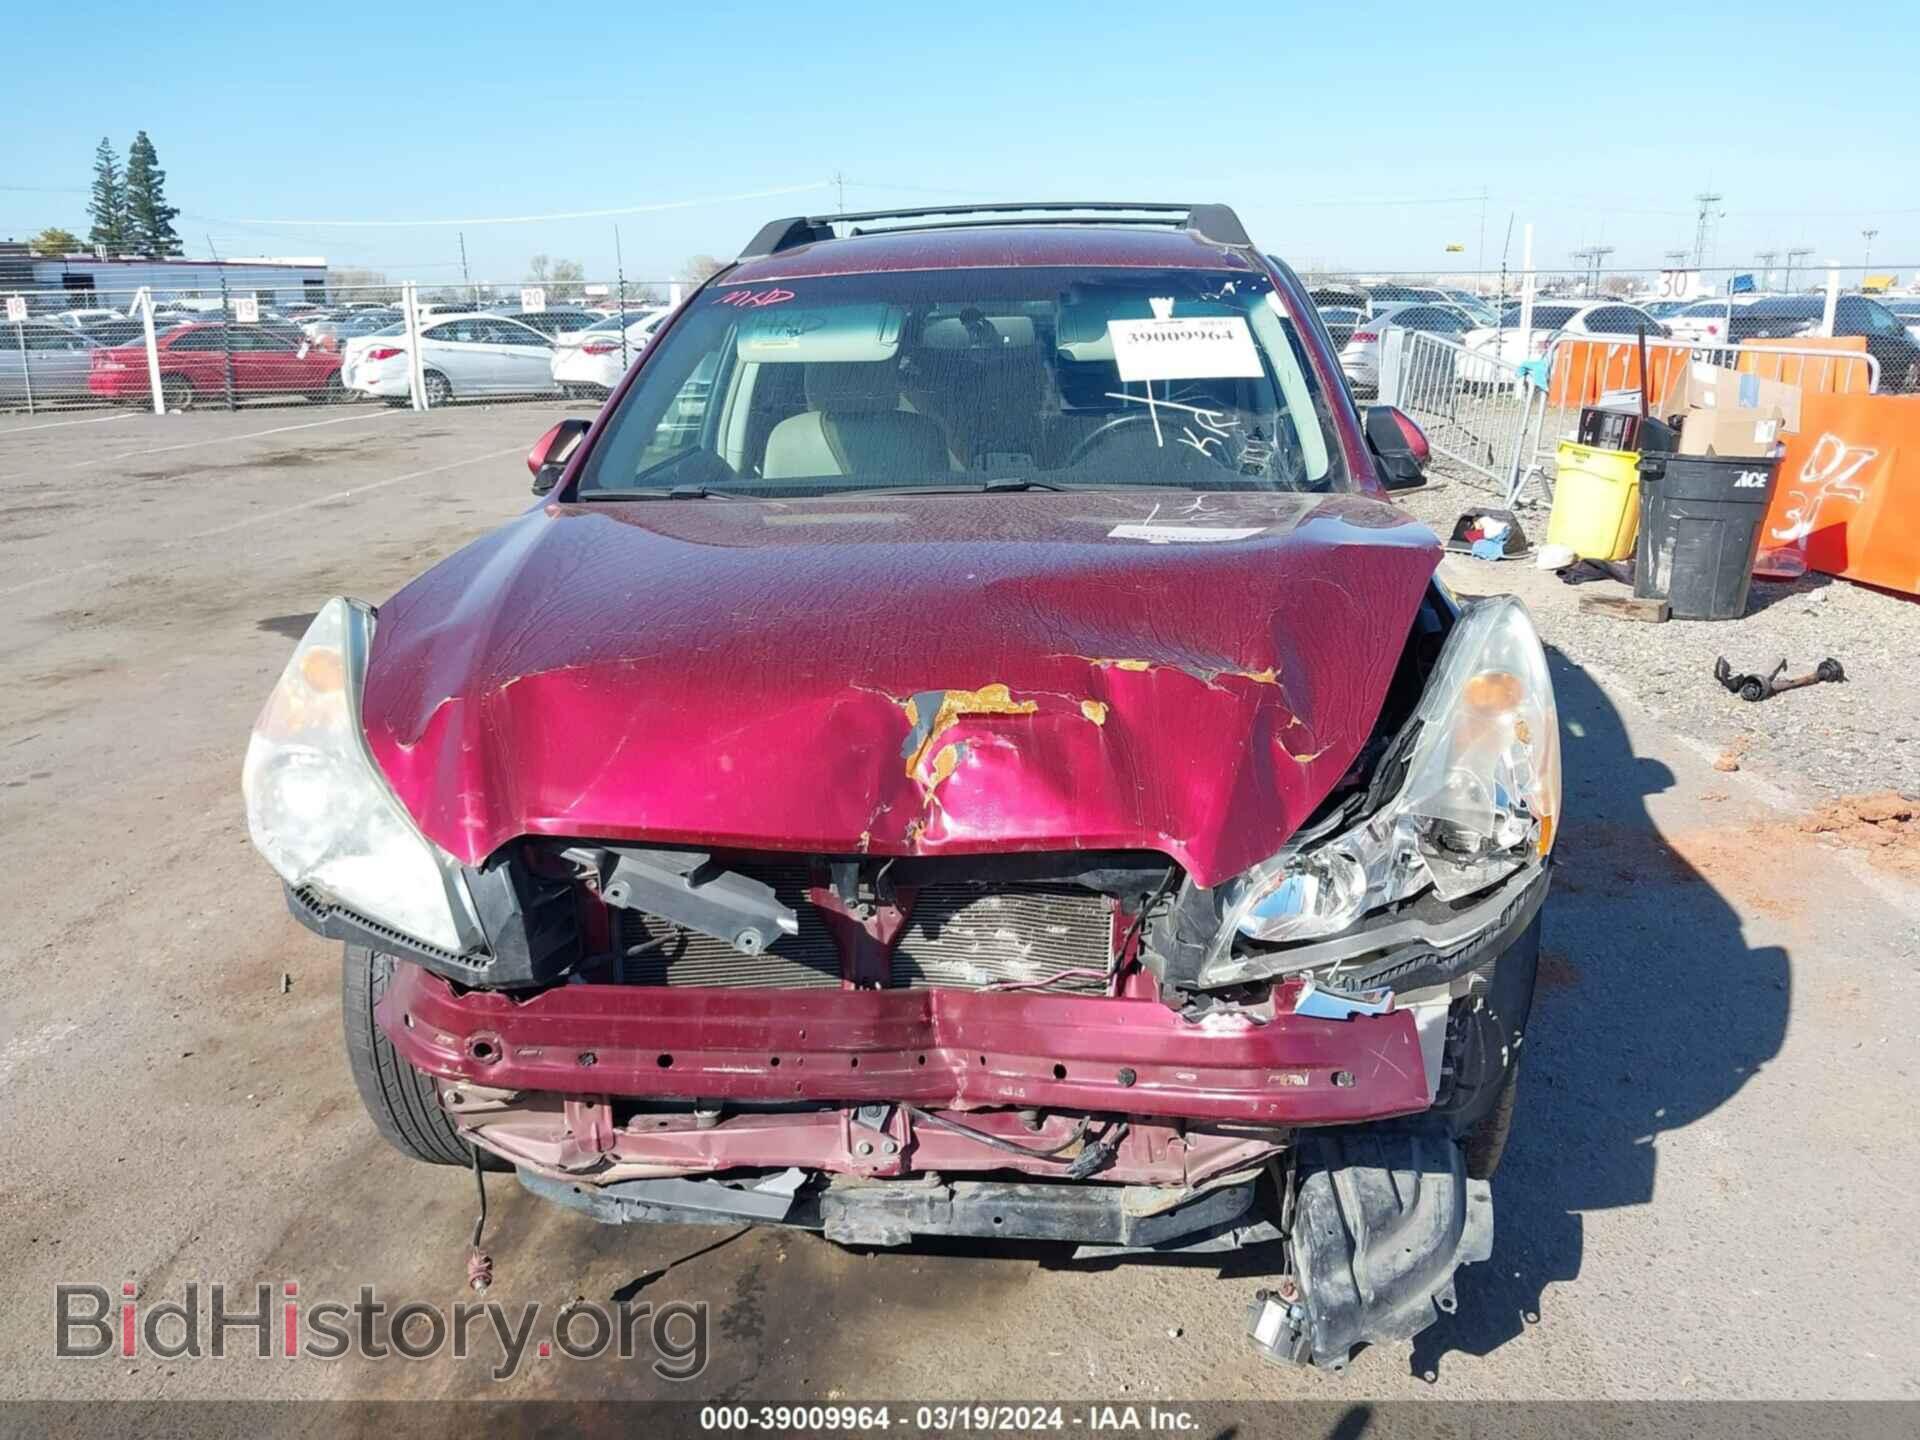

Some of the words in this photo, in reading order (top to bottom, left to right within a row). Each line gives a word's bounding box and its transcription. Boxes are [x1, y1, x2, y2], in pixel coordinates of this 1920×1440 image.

[1660, 270, 1688, 298] 30
[524, 290, 543, 306] 20
[239, 300, 255, 316] 19
[1127, 329, 1236, 345] 39009964
[1732, 469, 1769, 488] ACE
